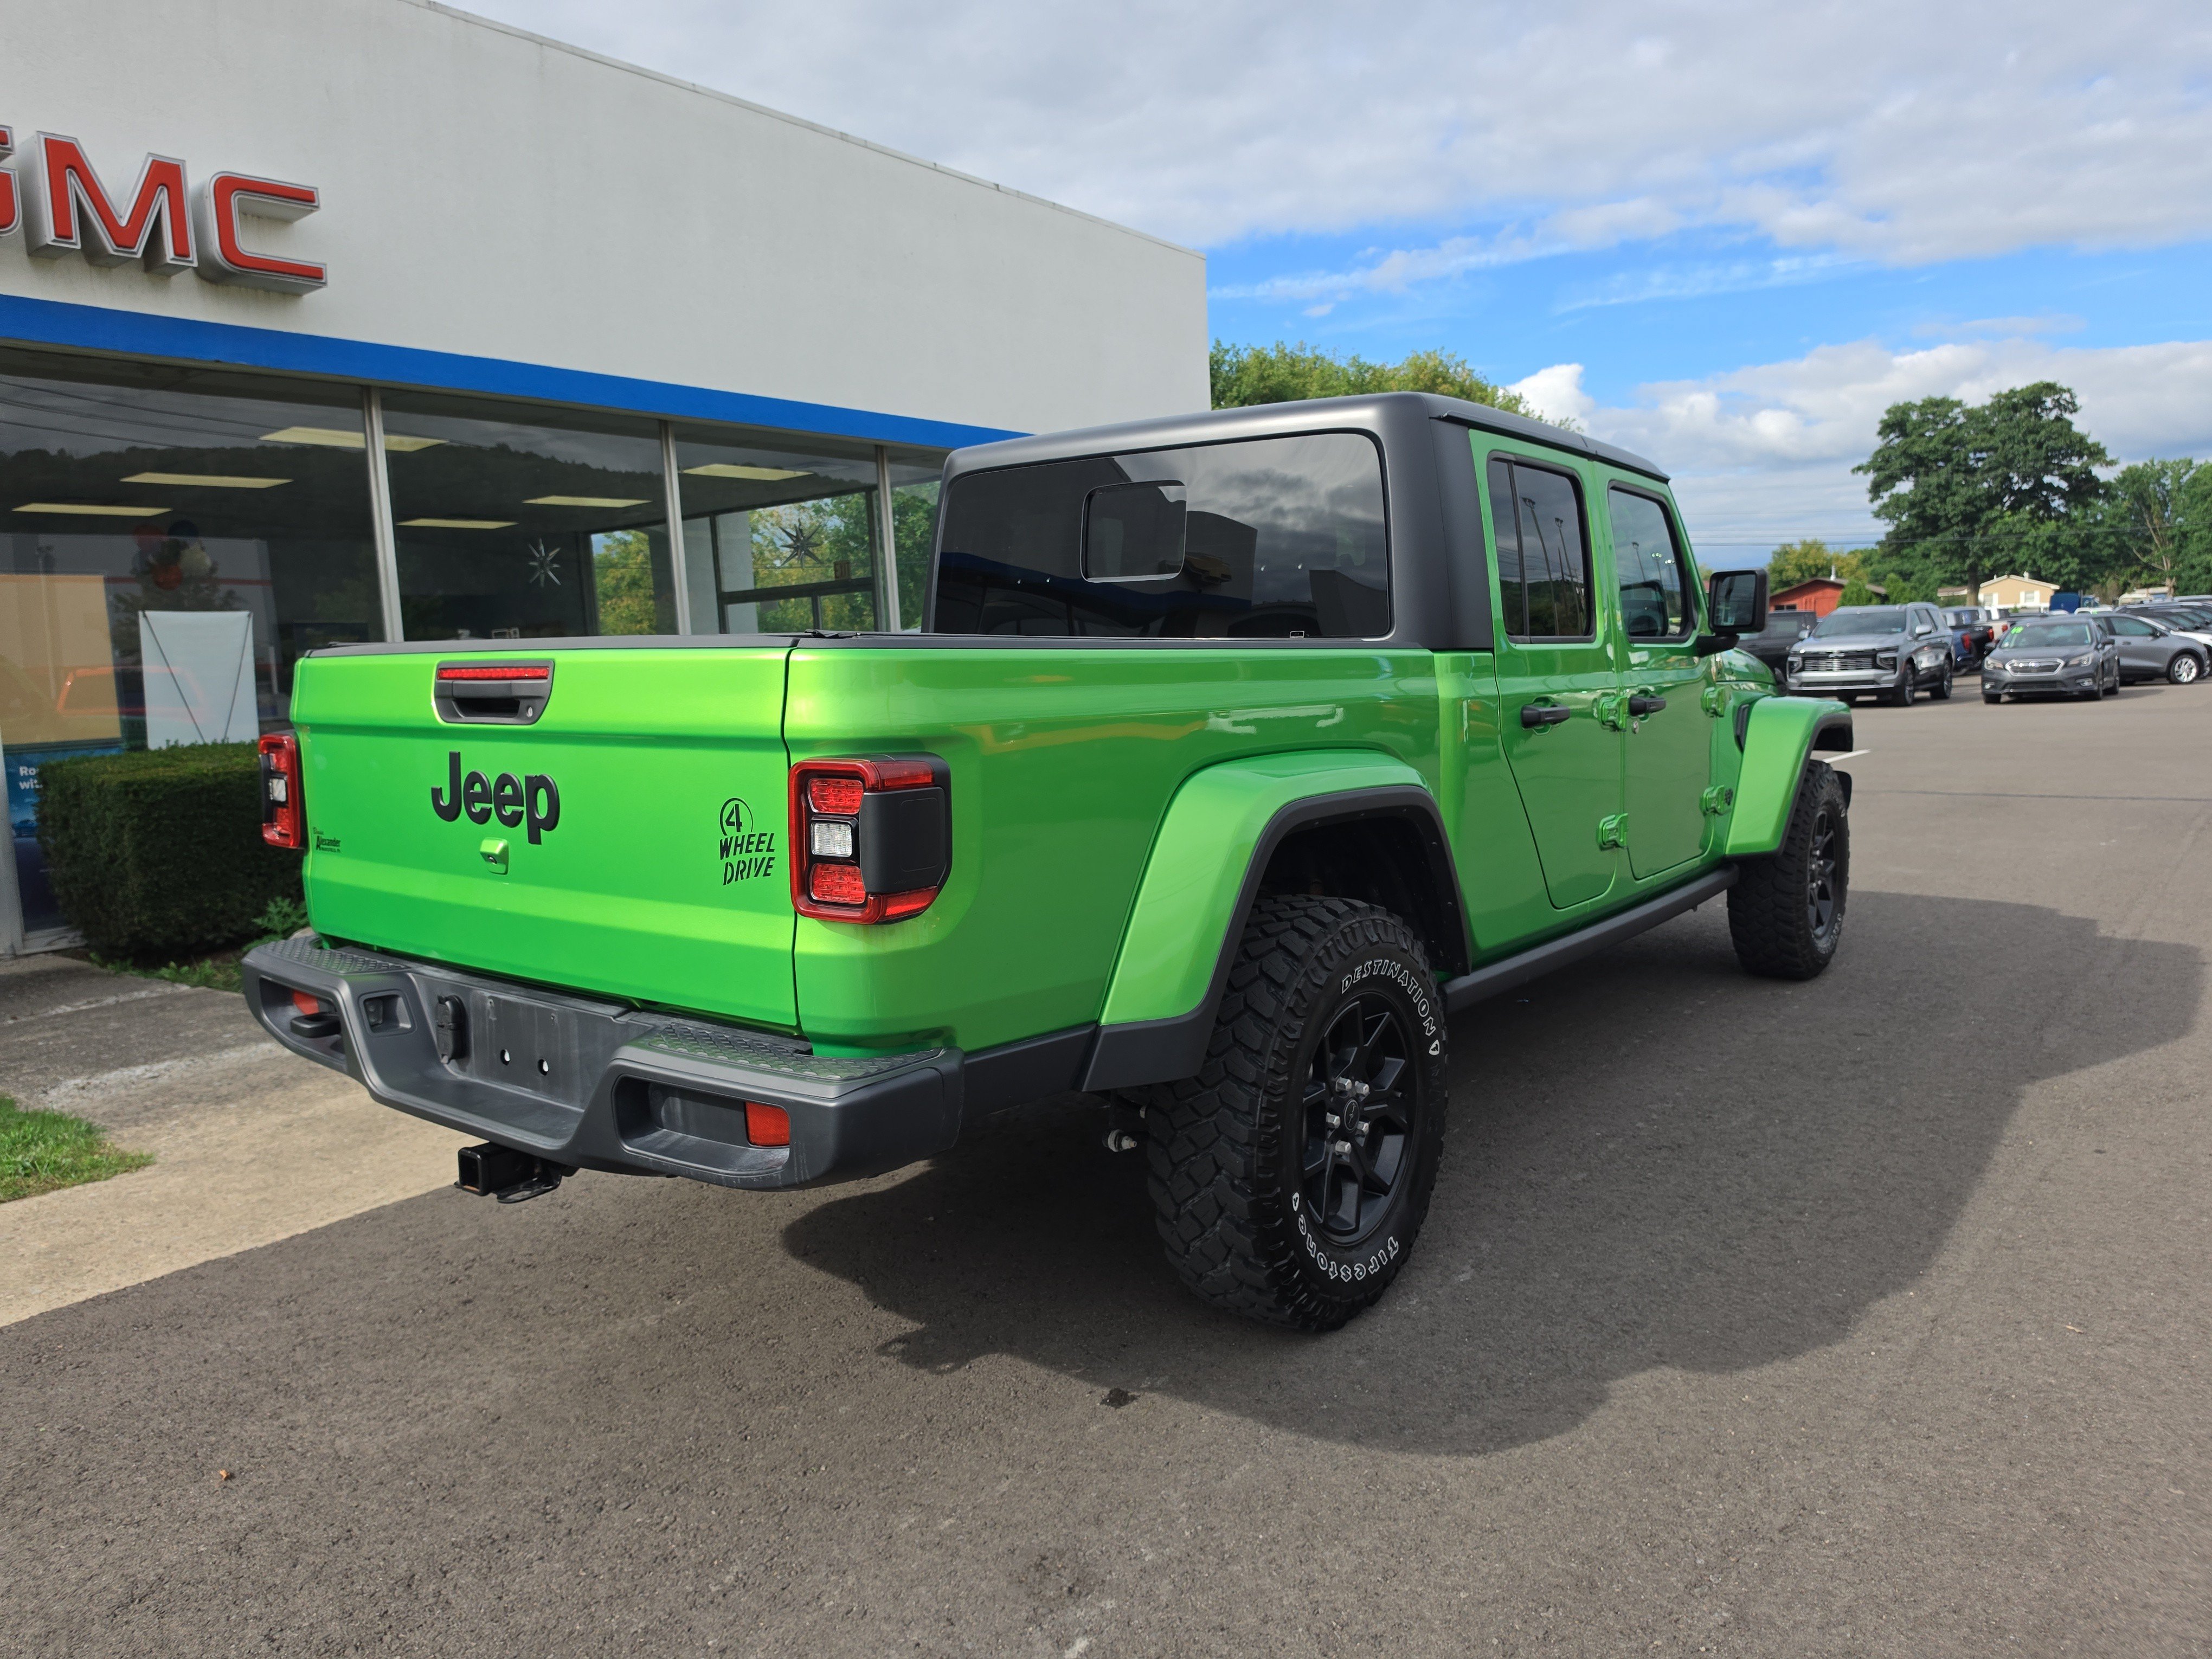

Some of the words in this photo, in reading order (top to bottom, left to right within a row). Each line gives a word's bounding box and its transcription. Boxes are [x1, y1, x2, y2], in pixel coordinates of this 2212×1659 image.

[0, 125, 328, 287] MC
[431, 751, 560, 845] Jeep
[725, 804, 743, 832] 4
[719, 833, 775, 860] WHEEL
[723, 857, 775, 885] DRIVE
[1341, 959, 1436, 1036] DESTINATION
